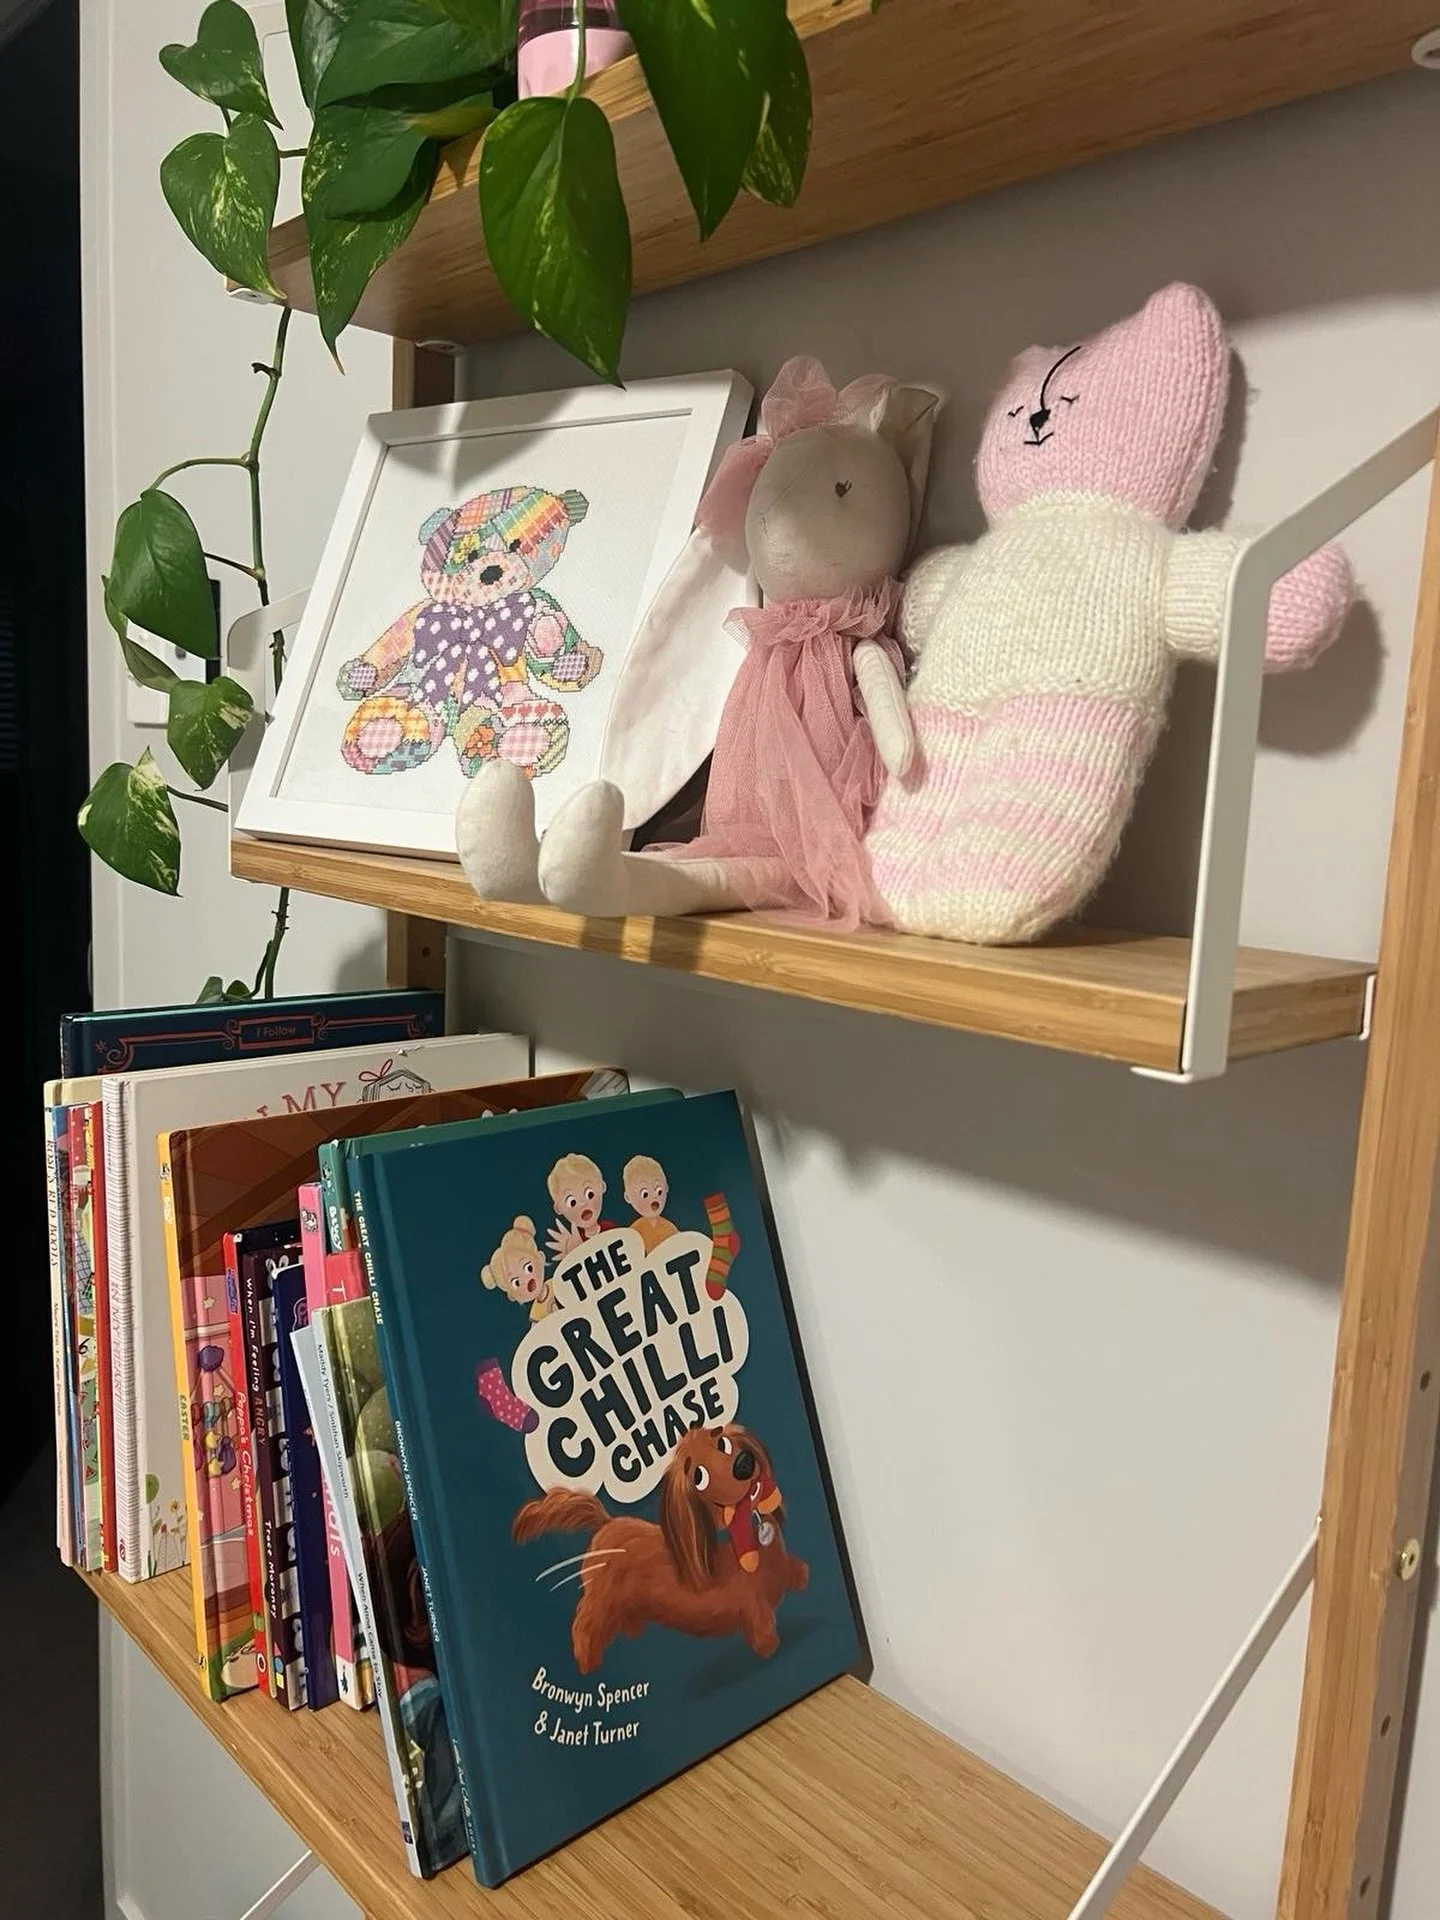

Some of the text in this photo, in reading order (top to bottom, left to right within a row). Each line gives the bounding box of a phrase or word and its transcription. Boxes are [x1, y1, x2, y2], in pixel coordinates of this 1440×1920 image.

[263, 1027, 296, 1038] Follow
[46, 1139, 59, 1267] ROSE'S RED BOOTS
[354, 1190, 384, 1325] THE GREAT CHILLI CHASE
[561, 1239, 632, 1302] THE
[246, 1277, 265, 1446] When I'm Feeling ANGRY
[317, 1343, 329, 1376] Maddy
[526, 1249, 702, 1408] GREAT
[179, 1394, 190, 1441] EASTER
[322, 1378, 333, 1402] Tyers
[547, 1305, 735, 1479] CHILLI
[238, 1391, 254, 1537] Peppa's Christmas
[328, 1410, 341, 1449] Siobhan
[611, 1376, 726, 1483] CHASE
[336, 1450, 349, 1499] Skipworth
[395, 1420, 418, 1521] BRONWYN SPENCER
[358, 1571, 384, 1698] When Anna Came to Stay
[420, 1565, 440, 1643] JANET TURNER
[532, 1666, 650, 1714] Bronwyn Spencer
[534, 1710, 640, 1746] & Janet Turner
